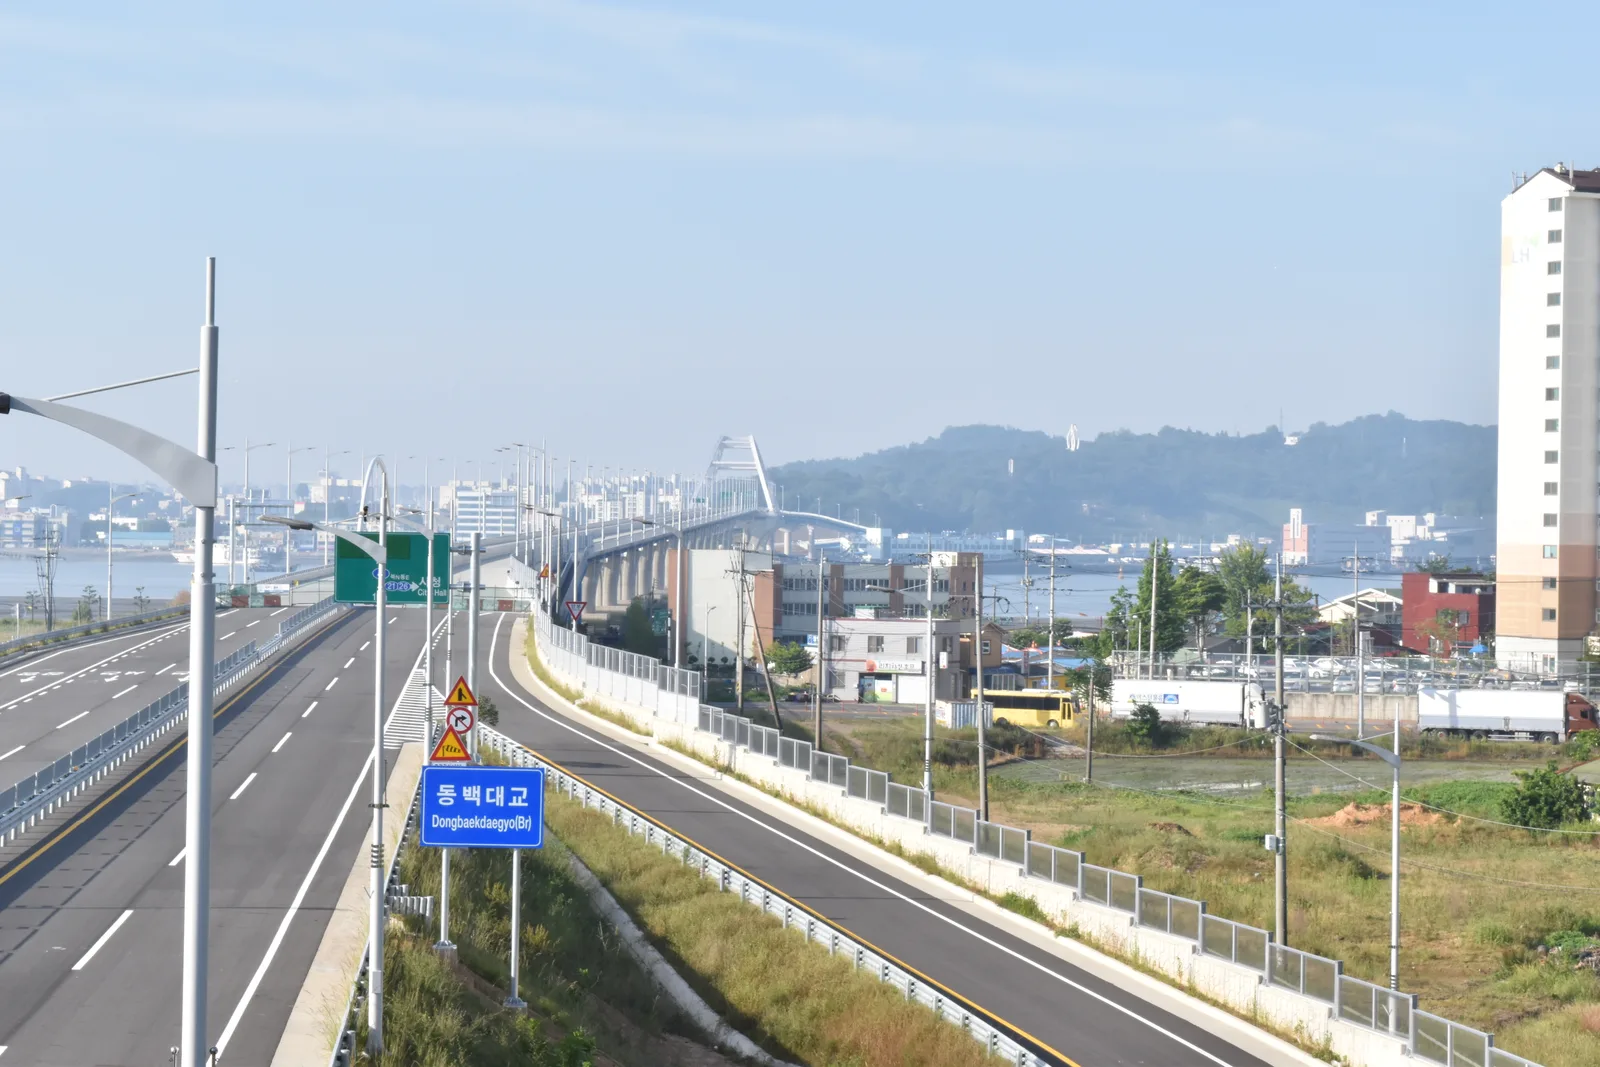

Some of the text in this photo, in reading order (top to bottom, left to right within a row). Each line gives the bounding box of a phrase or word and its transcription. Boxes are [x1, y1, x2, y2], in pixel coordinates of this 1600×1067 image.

[387, 582, 396, 590] 21
[398, 582, 408, 590] 26
[417, 588, 447, 597] Cit Hall
[436, 784, 529, 807] 동백대교
[431, 813, 532, 831] Dongbaekdaegyo(Br)
